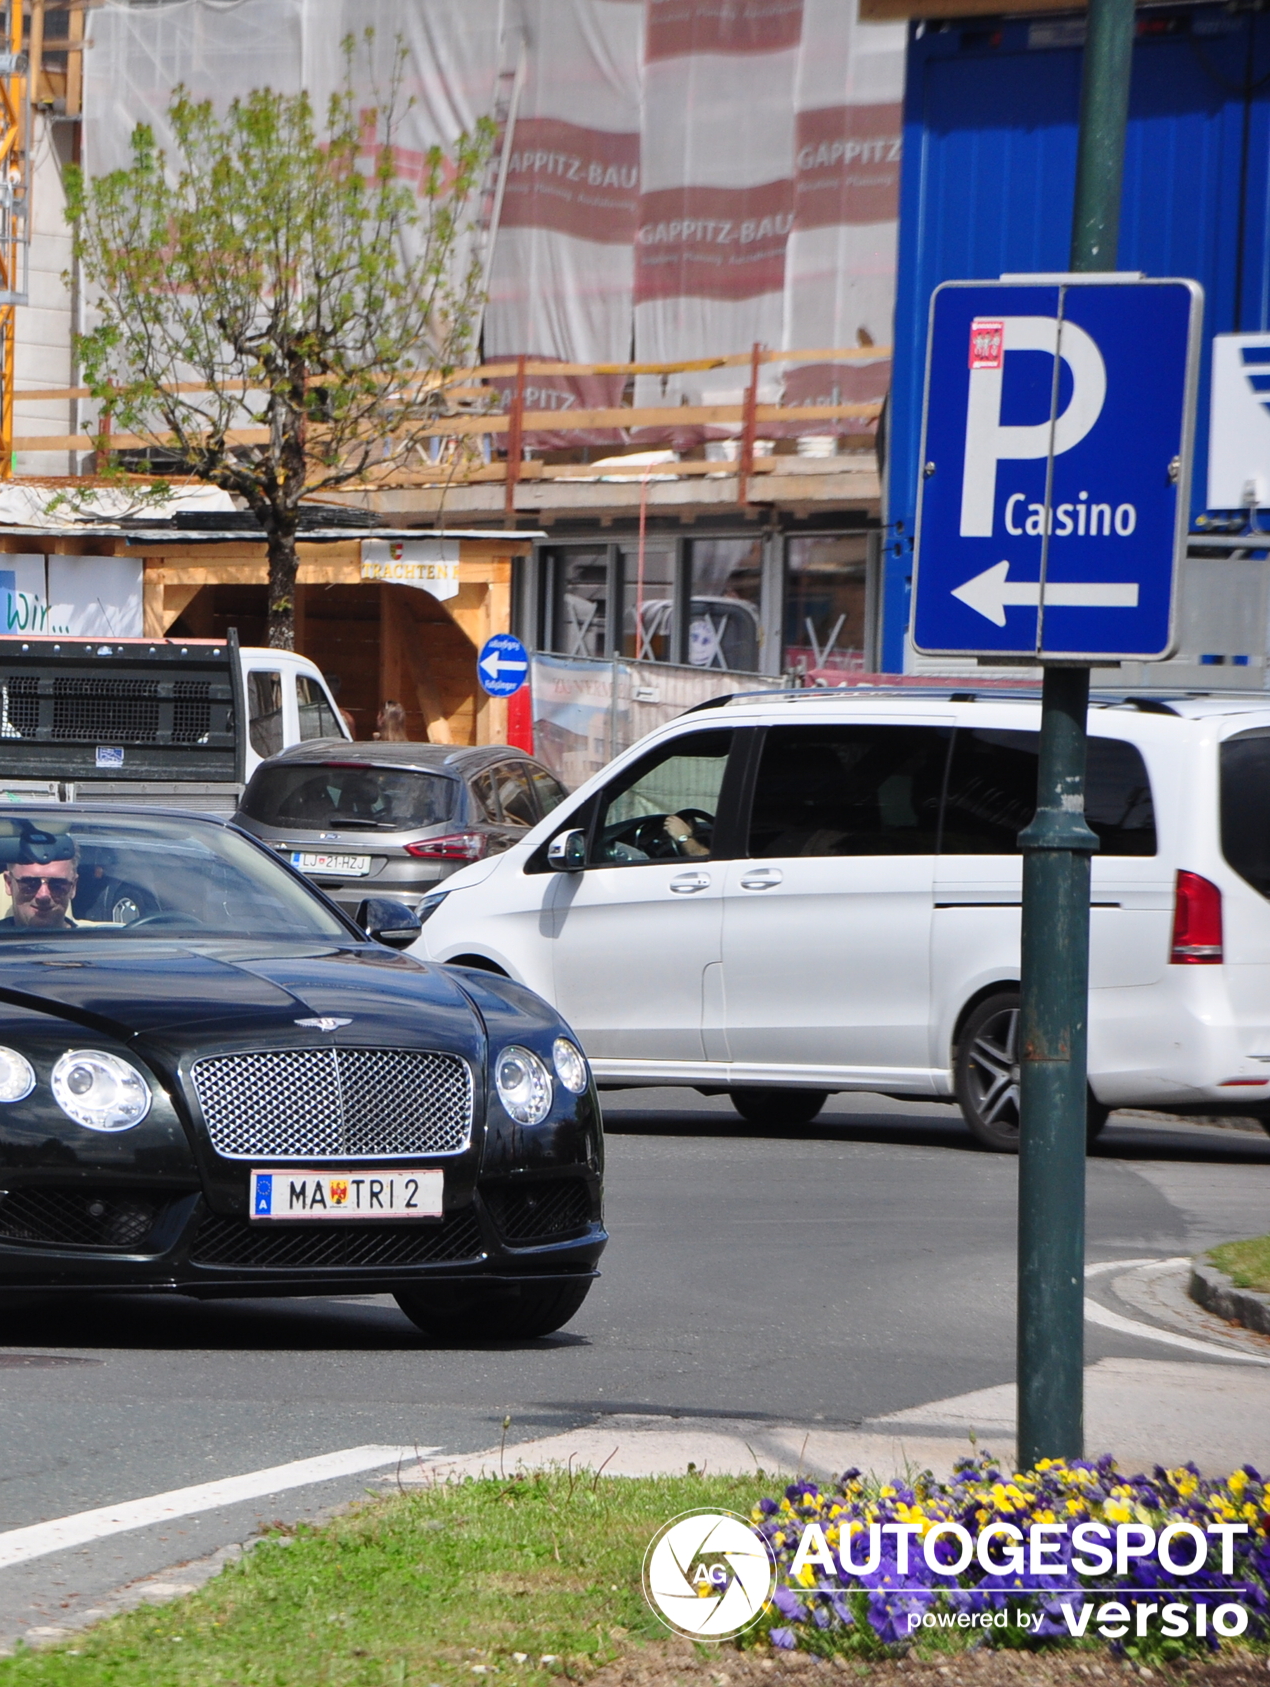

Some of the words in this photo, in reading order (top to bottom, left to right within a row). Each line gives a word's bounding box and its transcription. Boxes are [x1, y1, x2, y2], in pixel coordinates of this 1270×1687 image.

[507, 150, 639, 189] APPITZ-BAU
[639, 211, 796, 245] GAPPITZ-BAU
[960, 316, 1106, 537] P
[1005, 490, 1136, 536] Casino
[362, 563, 448, 580] TRACHTEN
[303, 854, 318, 867] LJ
[326, 855, 366, 870] 21-HZJ
[289, 1180, 327, 1210] MA
